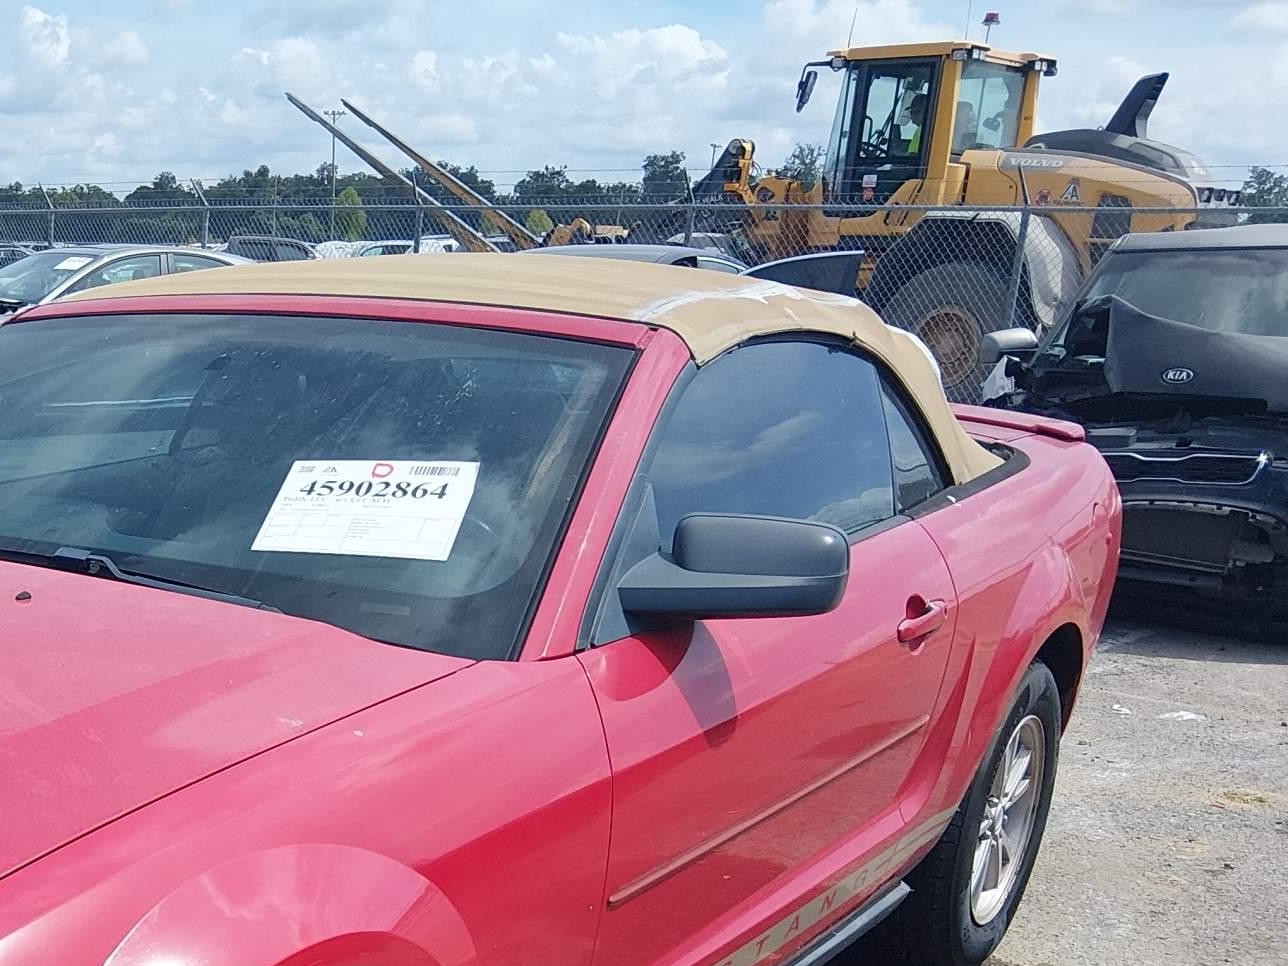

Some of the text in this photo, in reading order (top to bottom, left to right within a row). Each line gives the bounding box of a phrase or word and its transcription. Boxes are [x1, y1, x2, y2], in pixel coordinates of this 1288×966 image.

[1010, 158, 1064, 168] VOLVO
[1167, 370, 1187, 380] KIA
[299, 480, 449, 499] 45902864
